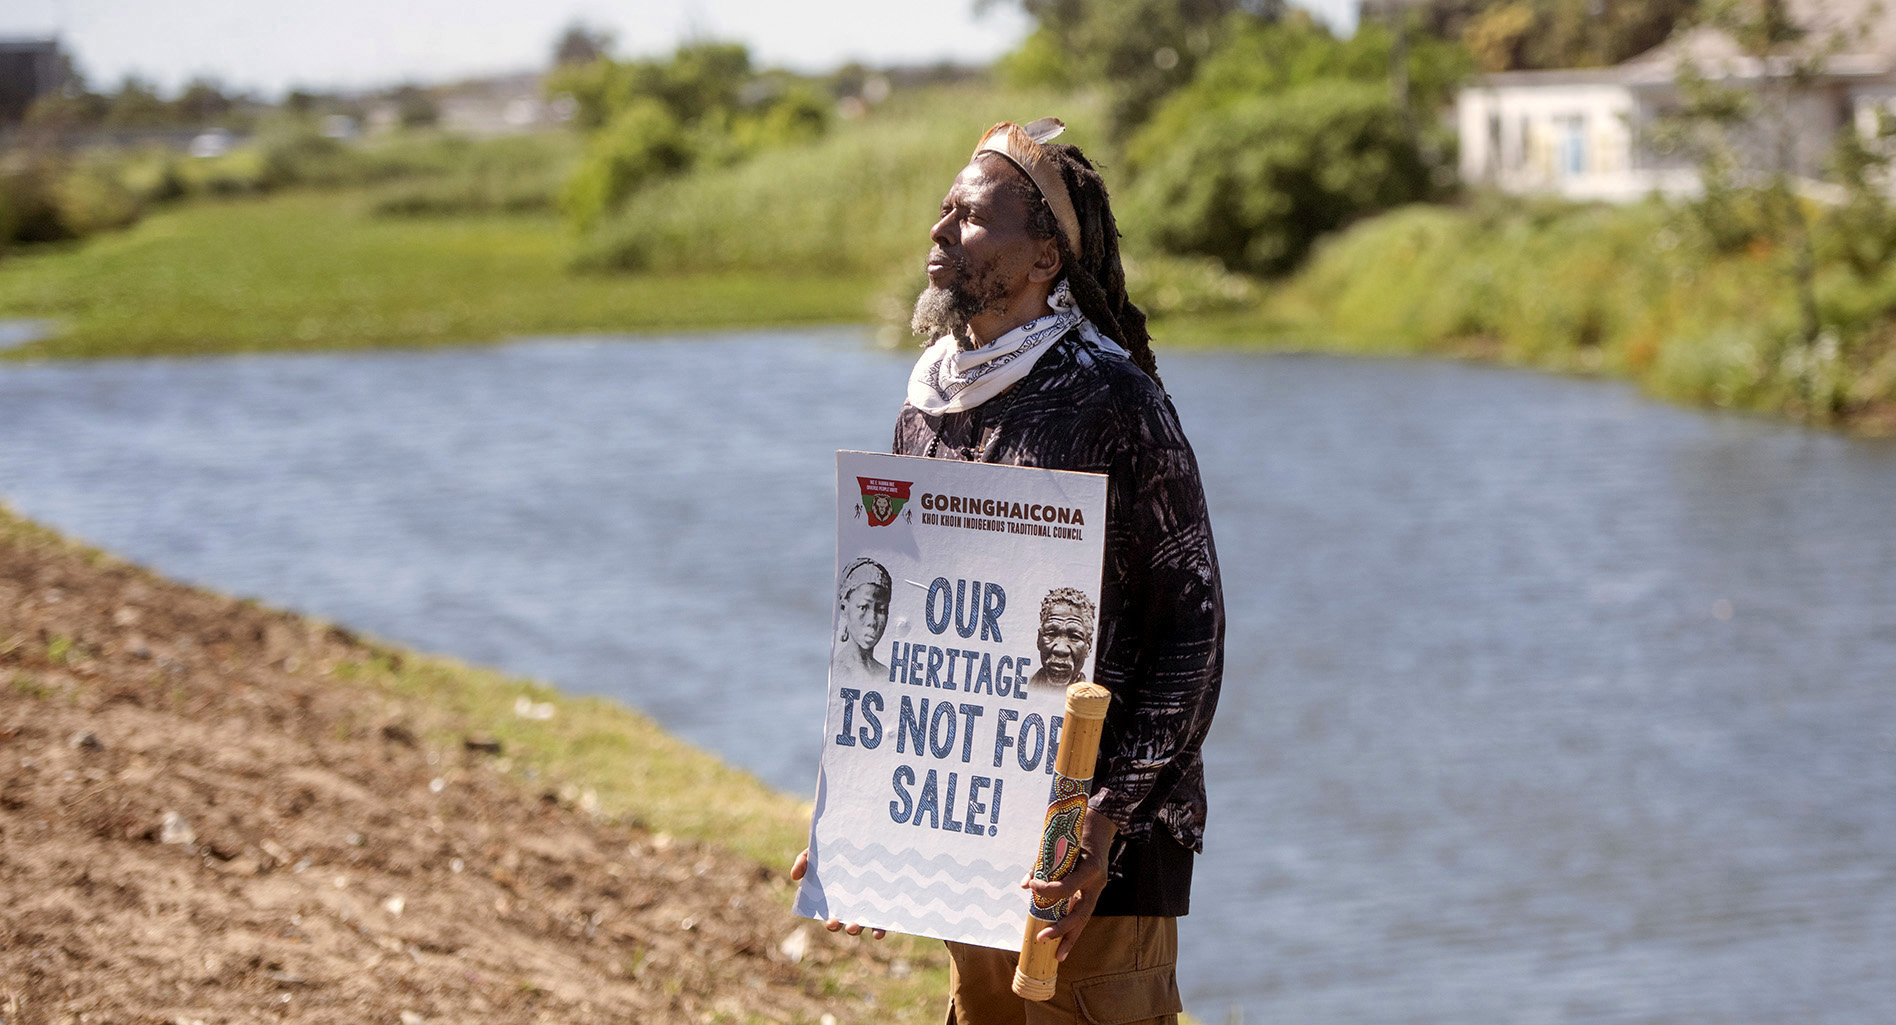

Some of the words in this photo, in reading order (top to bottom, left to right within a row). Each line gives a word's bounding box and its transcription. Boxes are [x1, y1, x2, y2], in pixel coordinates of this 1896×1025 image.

[921, 493, 1084, 526] GORINGHAICONA
[922, 513, 938, 526] KHOI
[940, 514, 961, 528] KHOIN
[963, 517, 1005, 533] INDIGENOUS
[1007, 521, 1051, 538] TRADITIONAL
[1053, 527, 1083, 541] COUNCIL
[925, 576, 1006, 643] OUR
[889, 641, 1031, 700] HERITAGE
[836, 687, 884, 750] IS
[896, 695, 984, 763] NOT
[889, 765, 1003, 837] SALE!
